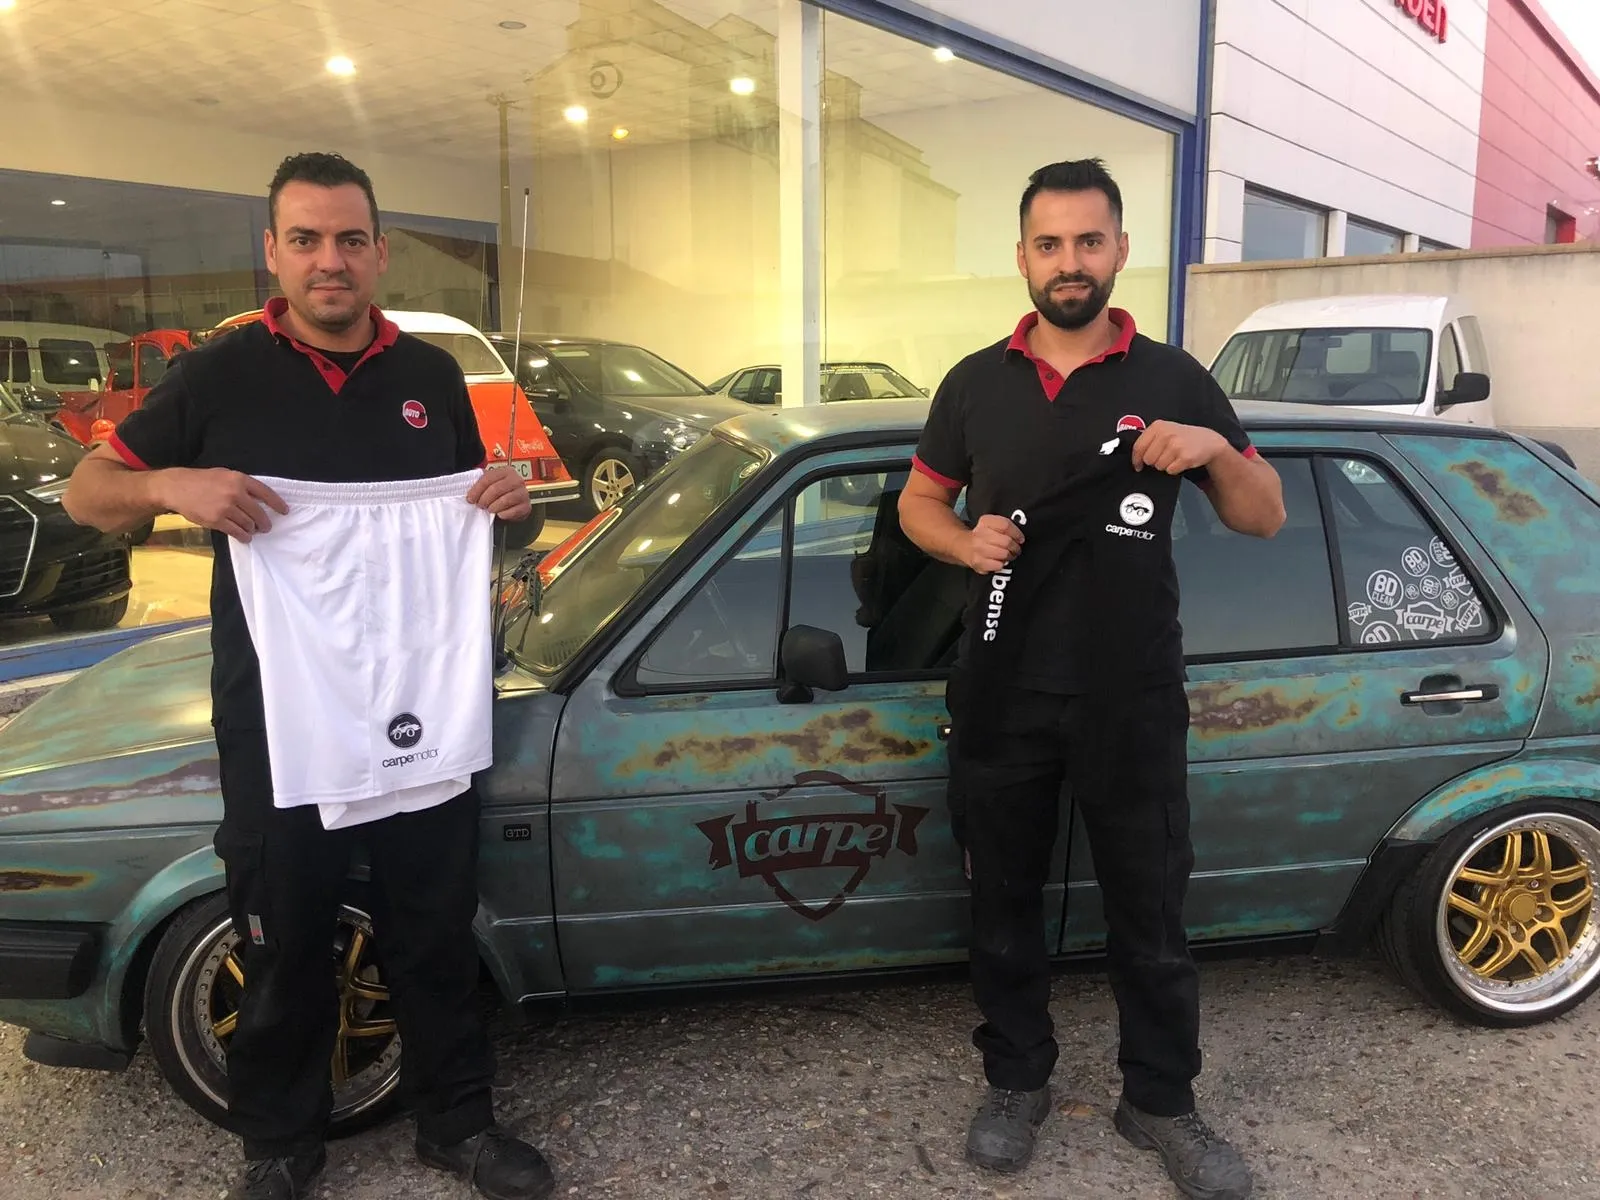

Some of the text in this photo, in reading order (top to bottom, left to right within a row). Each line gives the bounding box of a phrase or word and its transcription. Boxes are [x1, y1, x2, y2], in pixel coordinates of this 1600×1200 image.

[1105, 523, 1156, 541] carpemotor
[983, 561, 1013, 642] lbense
[1372, 590, 1395, 607] CLEAN
[1406, 615, 1444, 629] carpe
[382, 748, 439, 768] carpemotor
[505, 828, 530, 838] GTD
[744, 820, 888, 864] carpe
